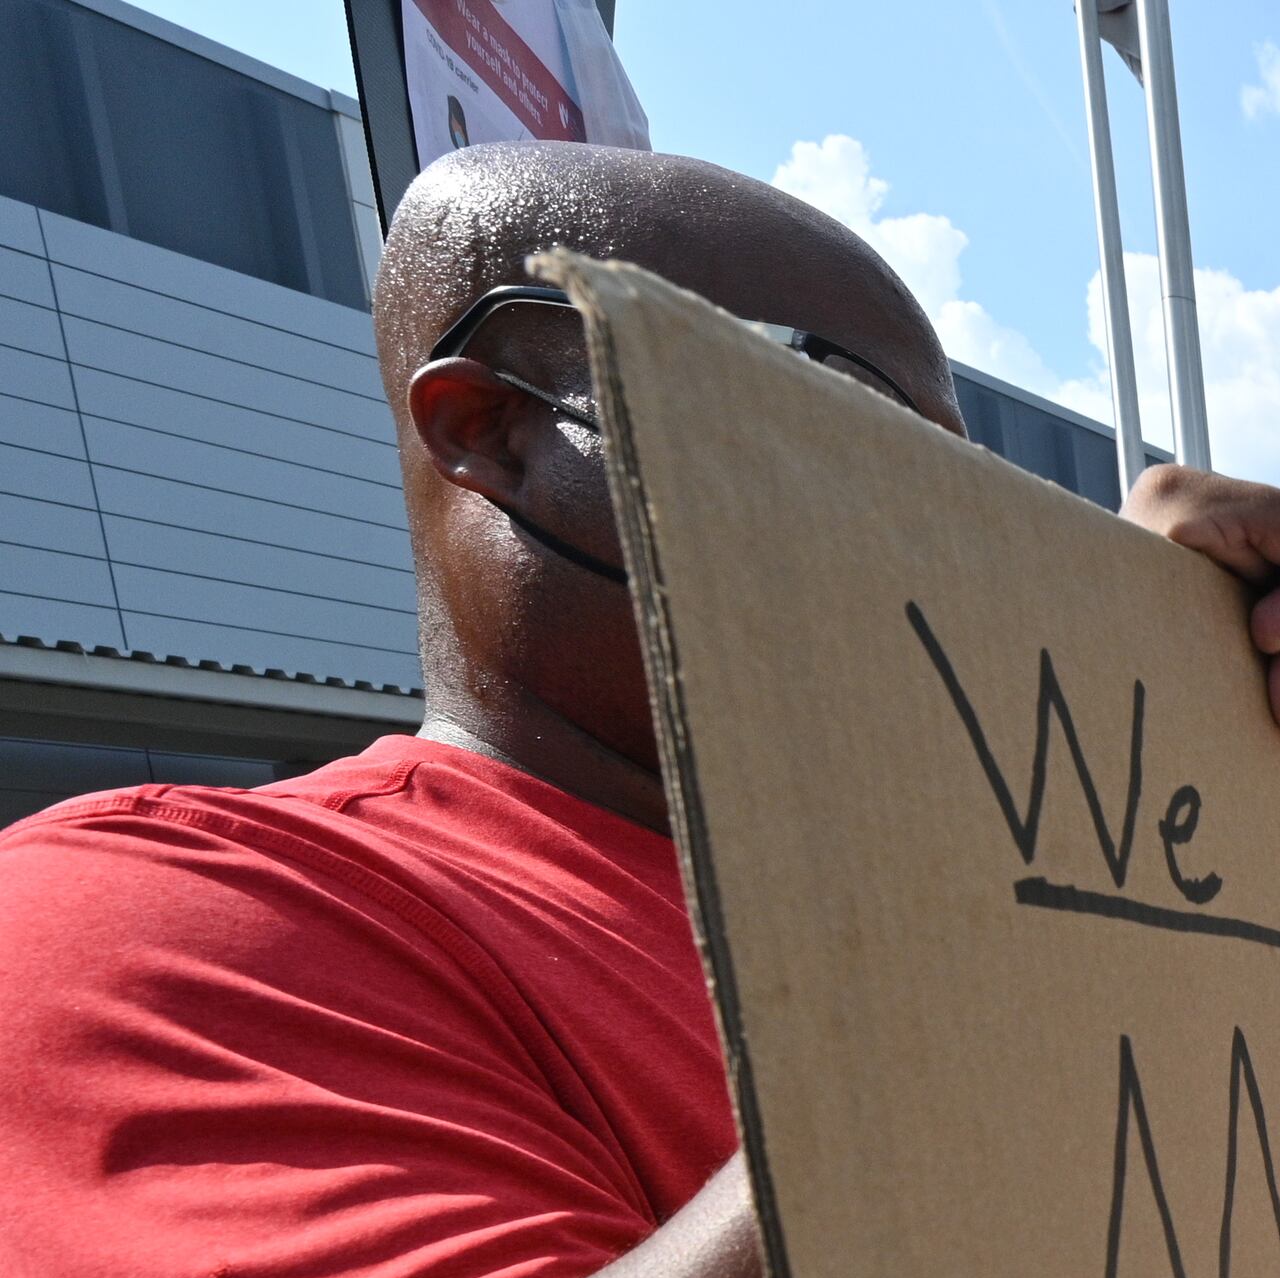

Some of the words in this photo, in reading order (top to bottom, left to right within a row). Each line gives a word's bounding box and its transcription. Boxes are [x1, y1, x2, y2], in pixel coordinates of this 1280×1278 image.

[456, 0, 480, 31] Wear
[482, 26, 489, 41] a
[490, 34, 512, 70] mask
[511, 56, 521, 79] to
[522, 71, 549, 112] protect
[465, 30, 501, 78] yourself
[503, 72, 517, 97] and
[905, 601, 1223, 905] We
